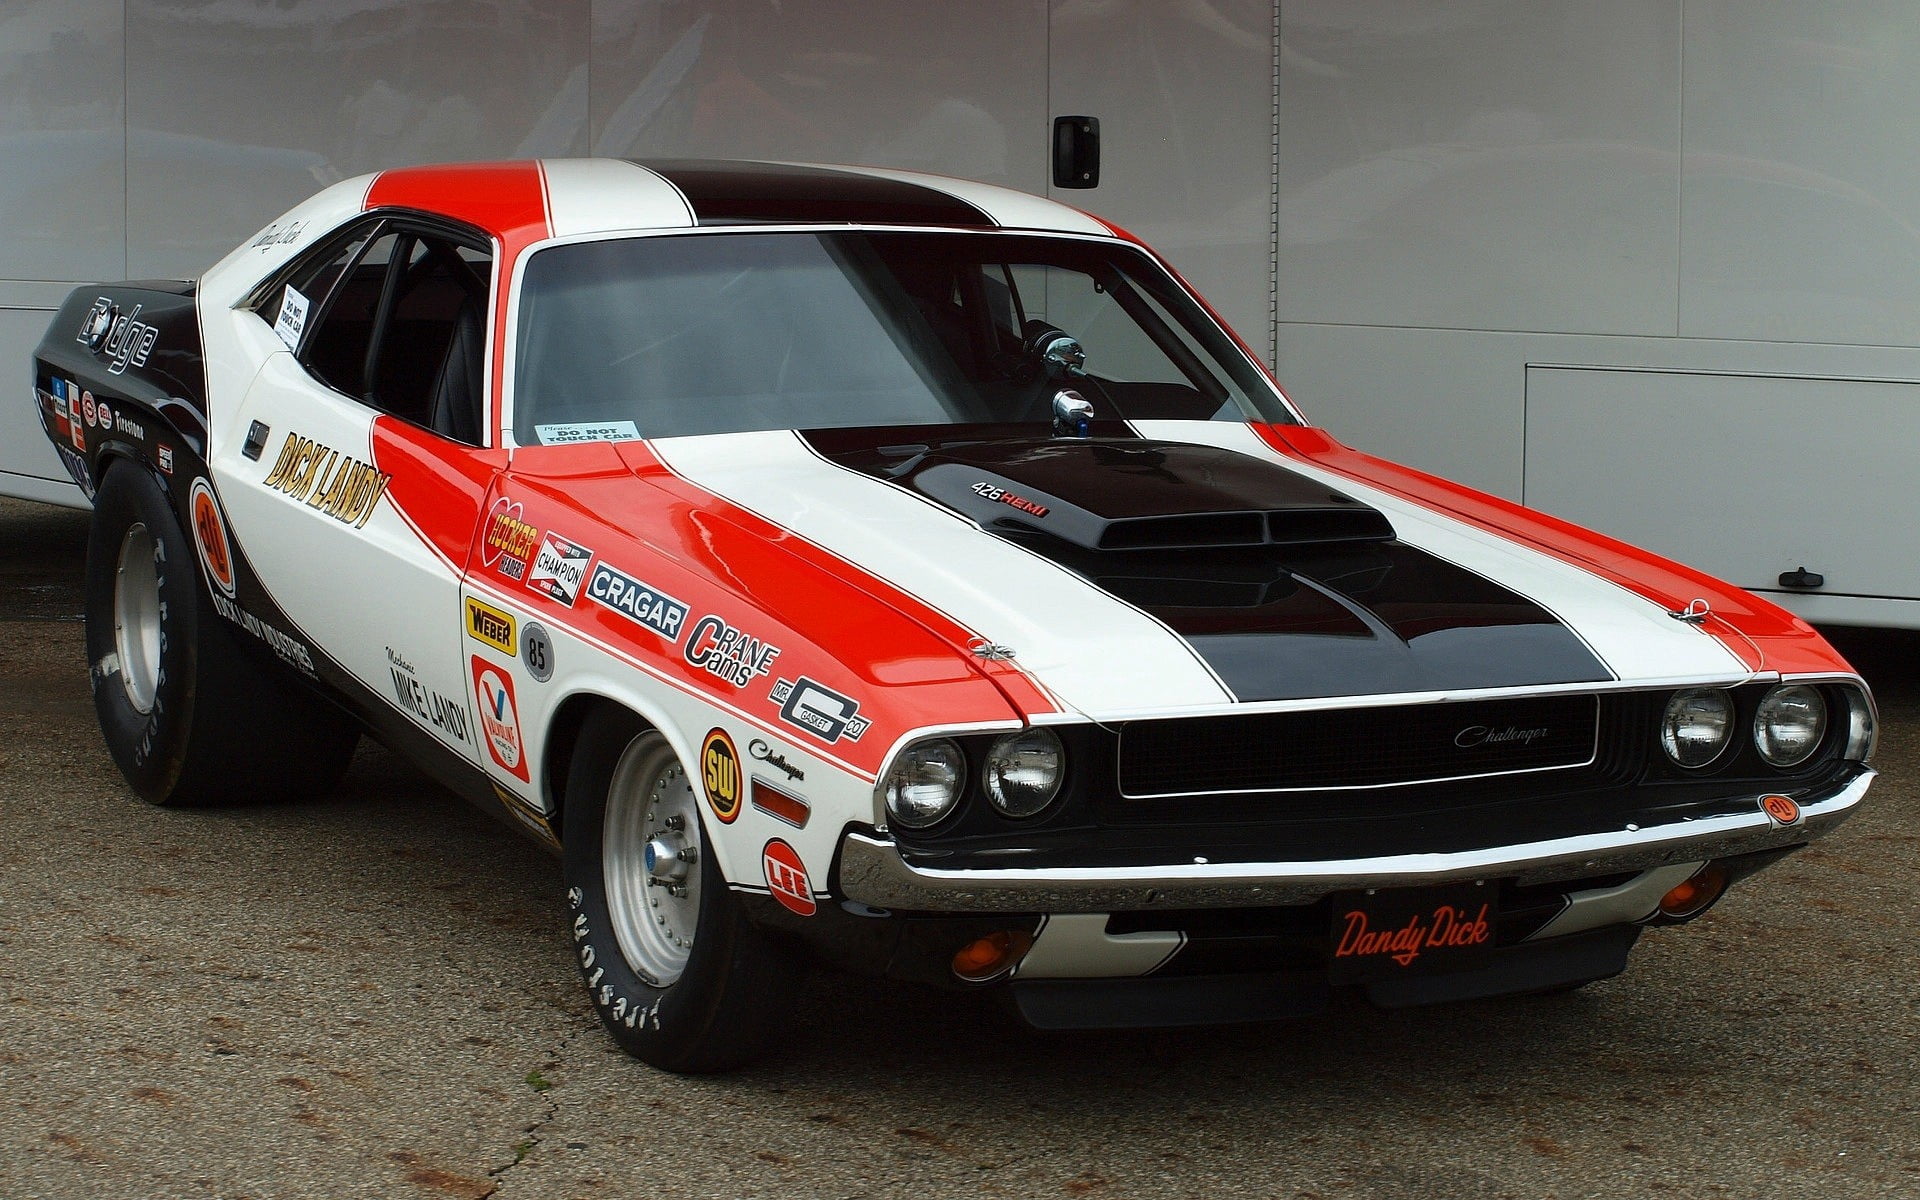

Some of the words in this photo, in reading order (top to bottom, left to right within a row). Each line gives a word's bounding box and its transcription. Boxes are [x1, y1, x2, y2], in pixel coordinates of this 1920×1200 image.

[115, 410, 144, 440] Firestone
[263, 431, 330, 502] DICK
[306, 451, 393, 530] LANDY
[970, 481, 1004, 501] 426
[1000, 492, 1049, 517] HEMI
[487, 513, 538, 561] HOOKER
[500, 554, 525, 580] HEADERS
[537, 552, 582, 586] CHAMPION
[592, 570, 682, 636] CRAGAR
[469, 604, 511, 647] WEBER
[529, 637, 545, 671] 85
[390, 667, 428, 720] MIKE
[423, 685, 472, 746] LANDY
[800, 710, 829, 731] GASKET
[1454, 725, 1549, 748] Challenger
[707, 748, 735, 801] SW
[748, 738, 805, 781] Challenger
[766, 858, 811, 901] LEE
[1335, 910, 1427, 966] Dandy
[1425, 903, 1490, 948] Dick
